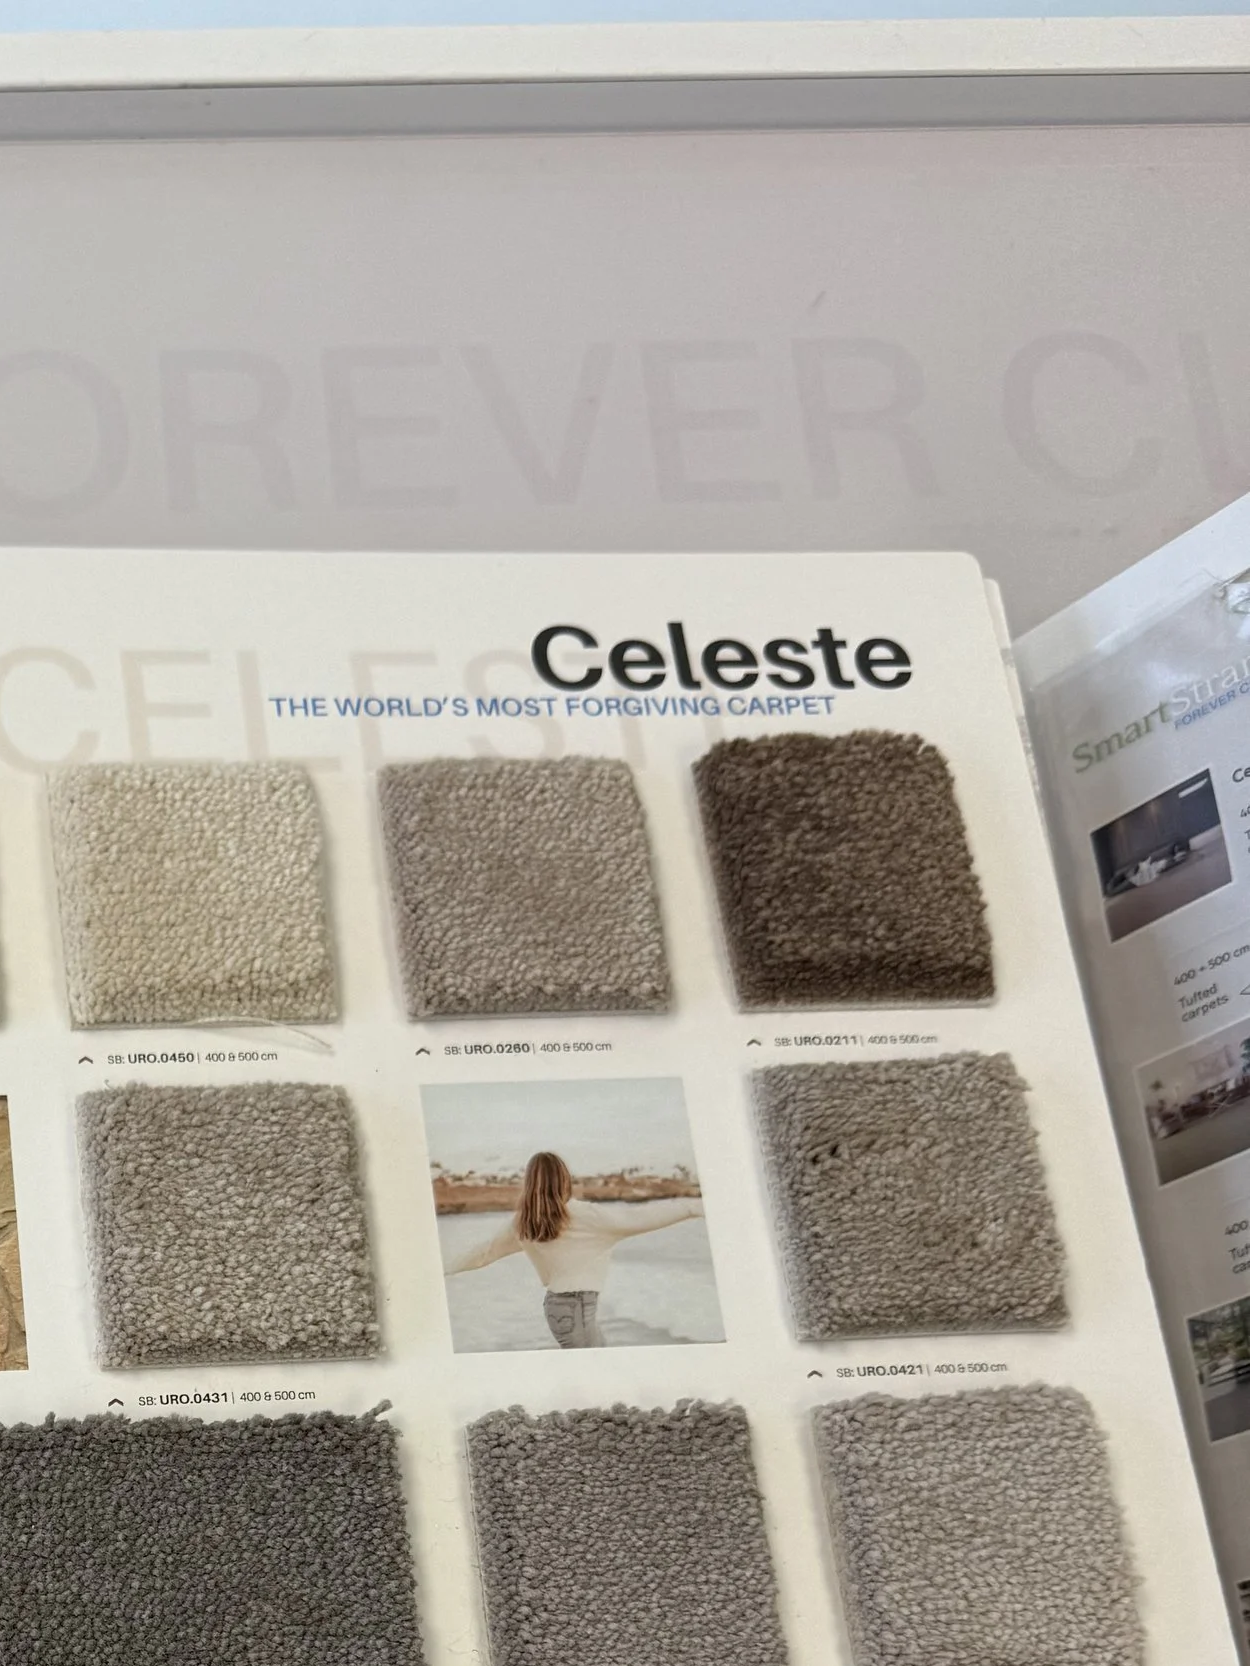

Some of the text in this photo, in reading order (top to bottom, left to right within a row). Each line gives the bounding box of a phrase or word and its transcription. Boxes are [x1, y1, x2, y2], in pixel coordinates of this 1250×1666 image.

[531, 622, 912, 692] Celeste
[269, 697, 327, 718] THE
[477, 696, 557, 717] MOST
[567, 695, 720, 717] FORGIVING
[727, 695, 836, 716] CARPET
[1181, 995, 1229, 1022] carpets
[107, 1052, 195, 1064] SB: URO.0450
[138, 1390, 316, 1406] SB: URO.0431 400 & 500 cm
